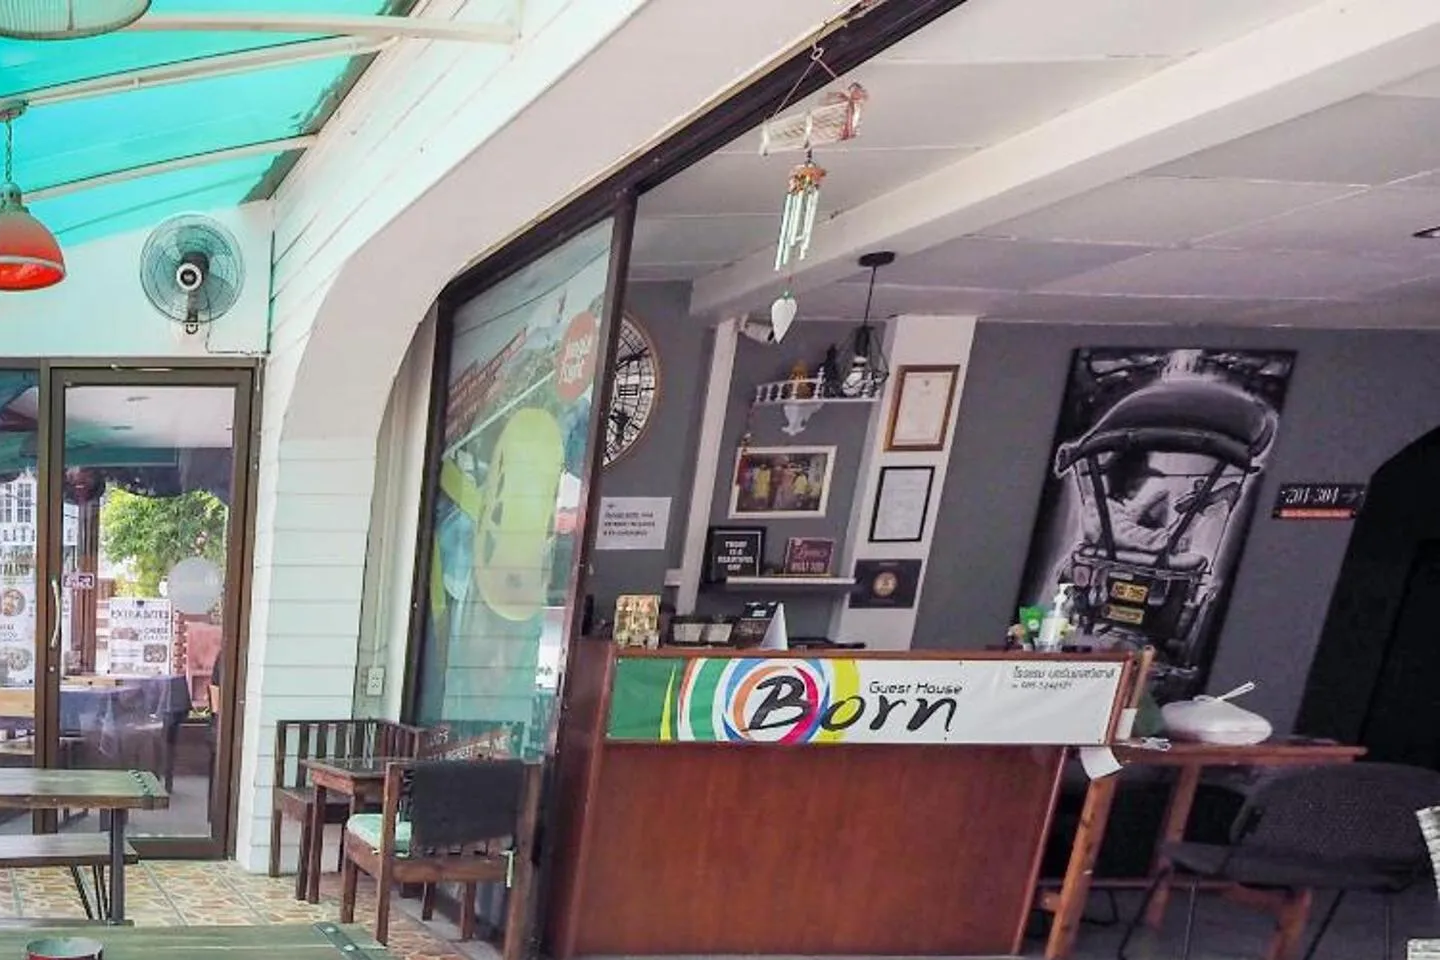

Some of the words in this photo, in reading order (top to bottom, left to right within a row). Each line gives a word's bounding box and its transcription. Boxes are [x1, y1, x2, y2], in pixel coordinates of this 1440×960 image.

[740, 675, 958, 732] Born
[869, 681, 911, 694] Guest
[915, 682, 963, 695] House
